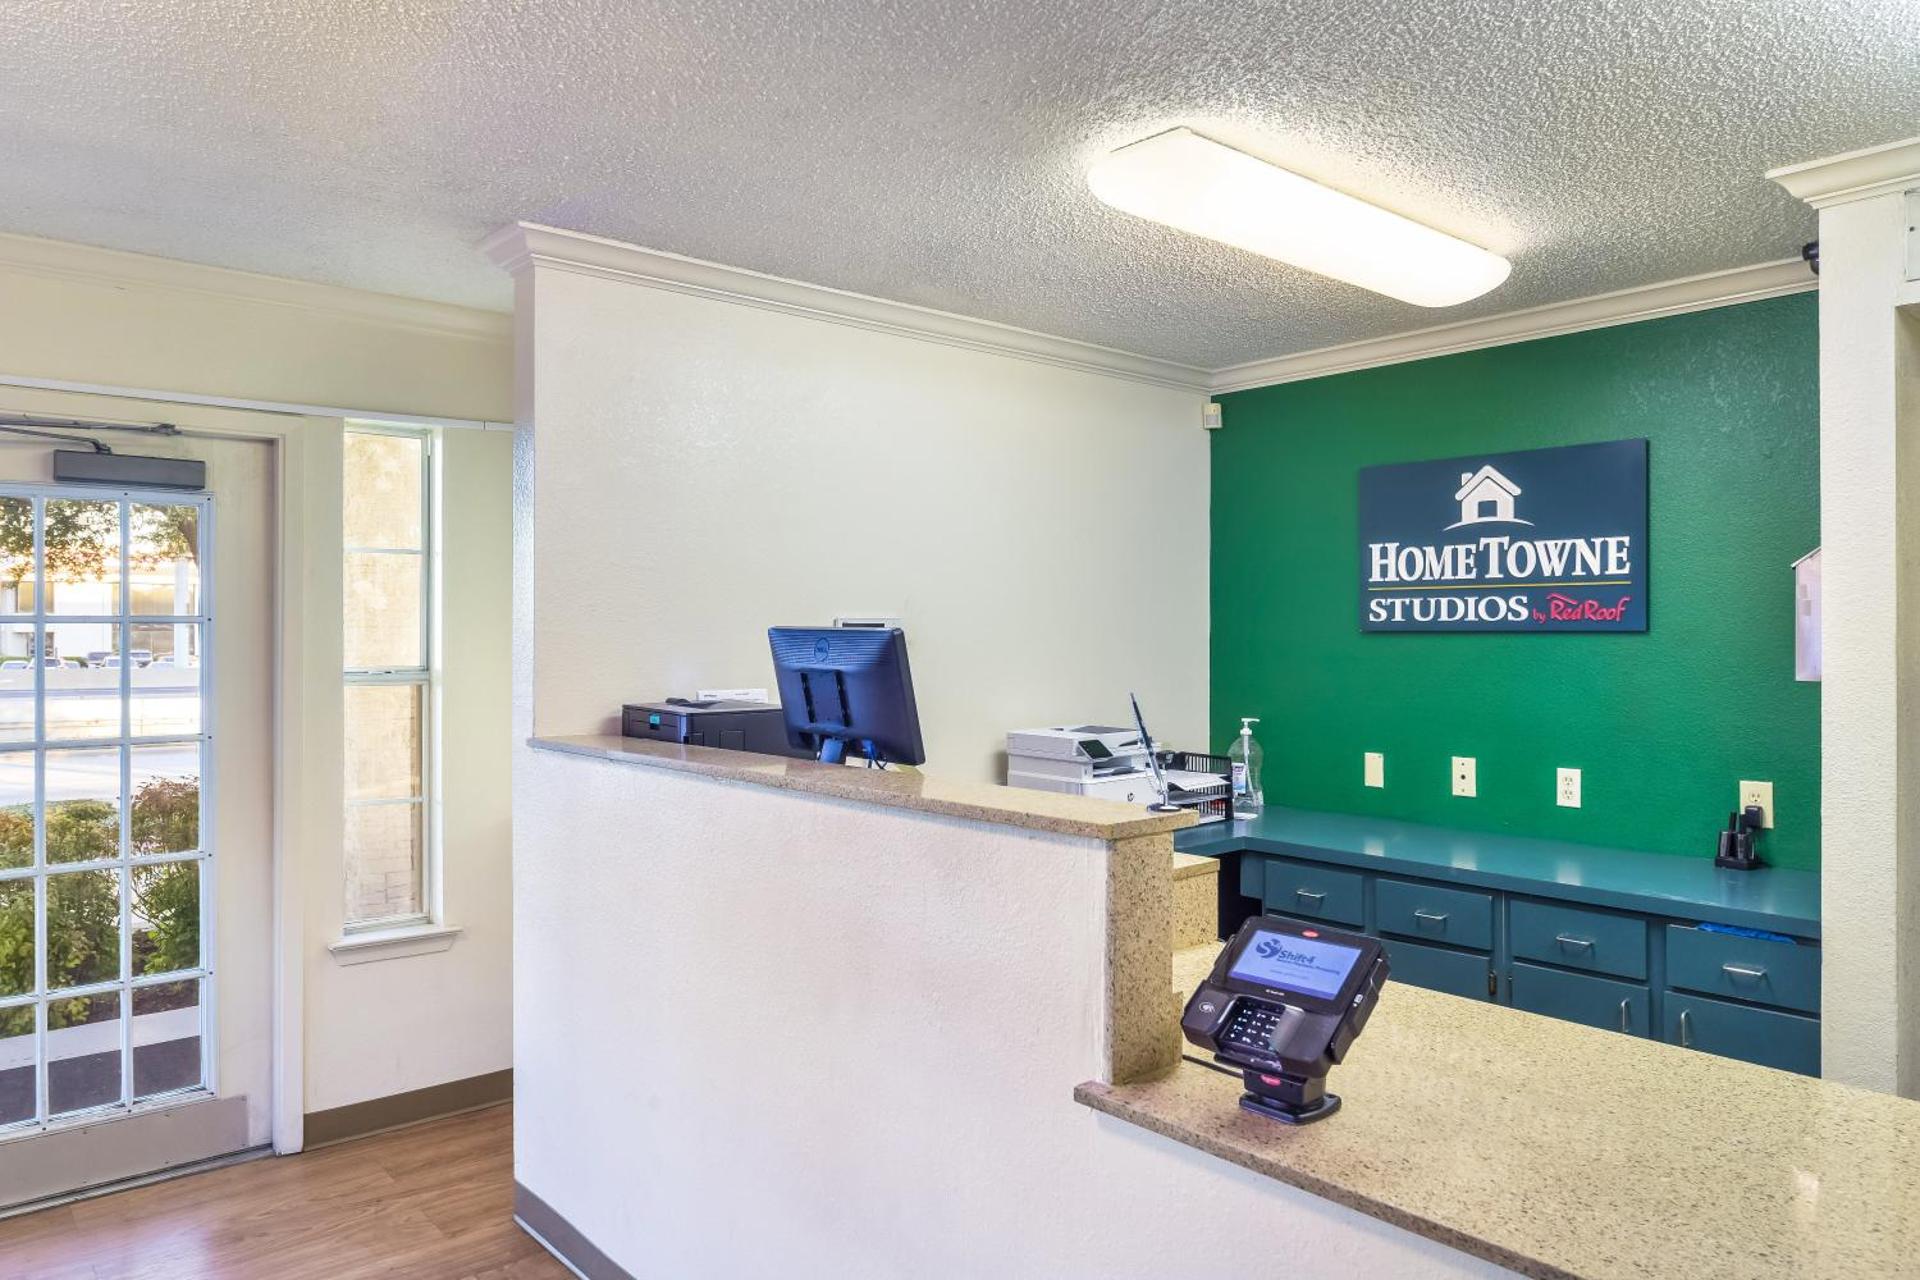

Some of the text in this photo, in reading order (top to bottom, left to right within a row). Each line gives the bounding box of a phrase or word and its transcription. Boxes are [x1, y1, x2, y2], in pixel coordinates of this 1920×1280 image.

[1368, 596, 1631, 624] STUDIOS by Red Roof
[1278, 950, 1317, 965] Shift4
